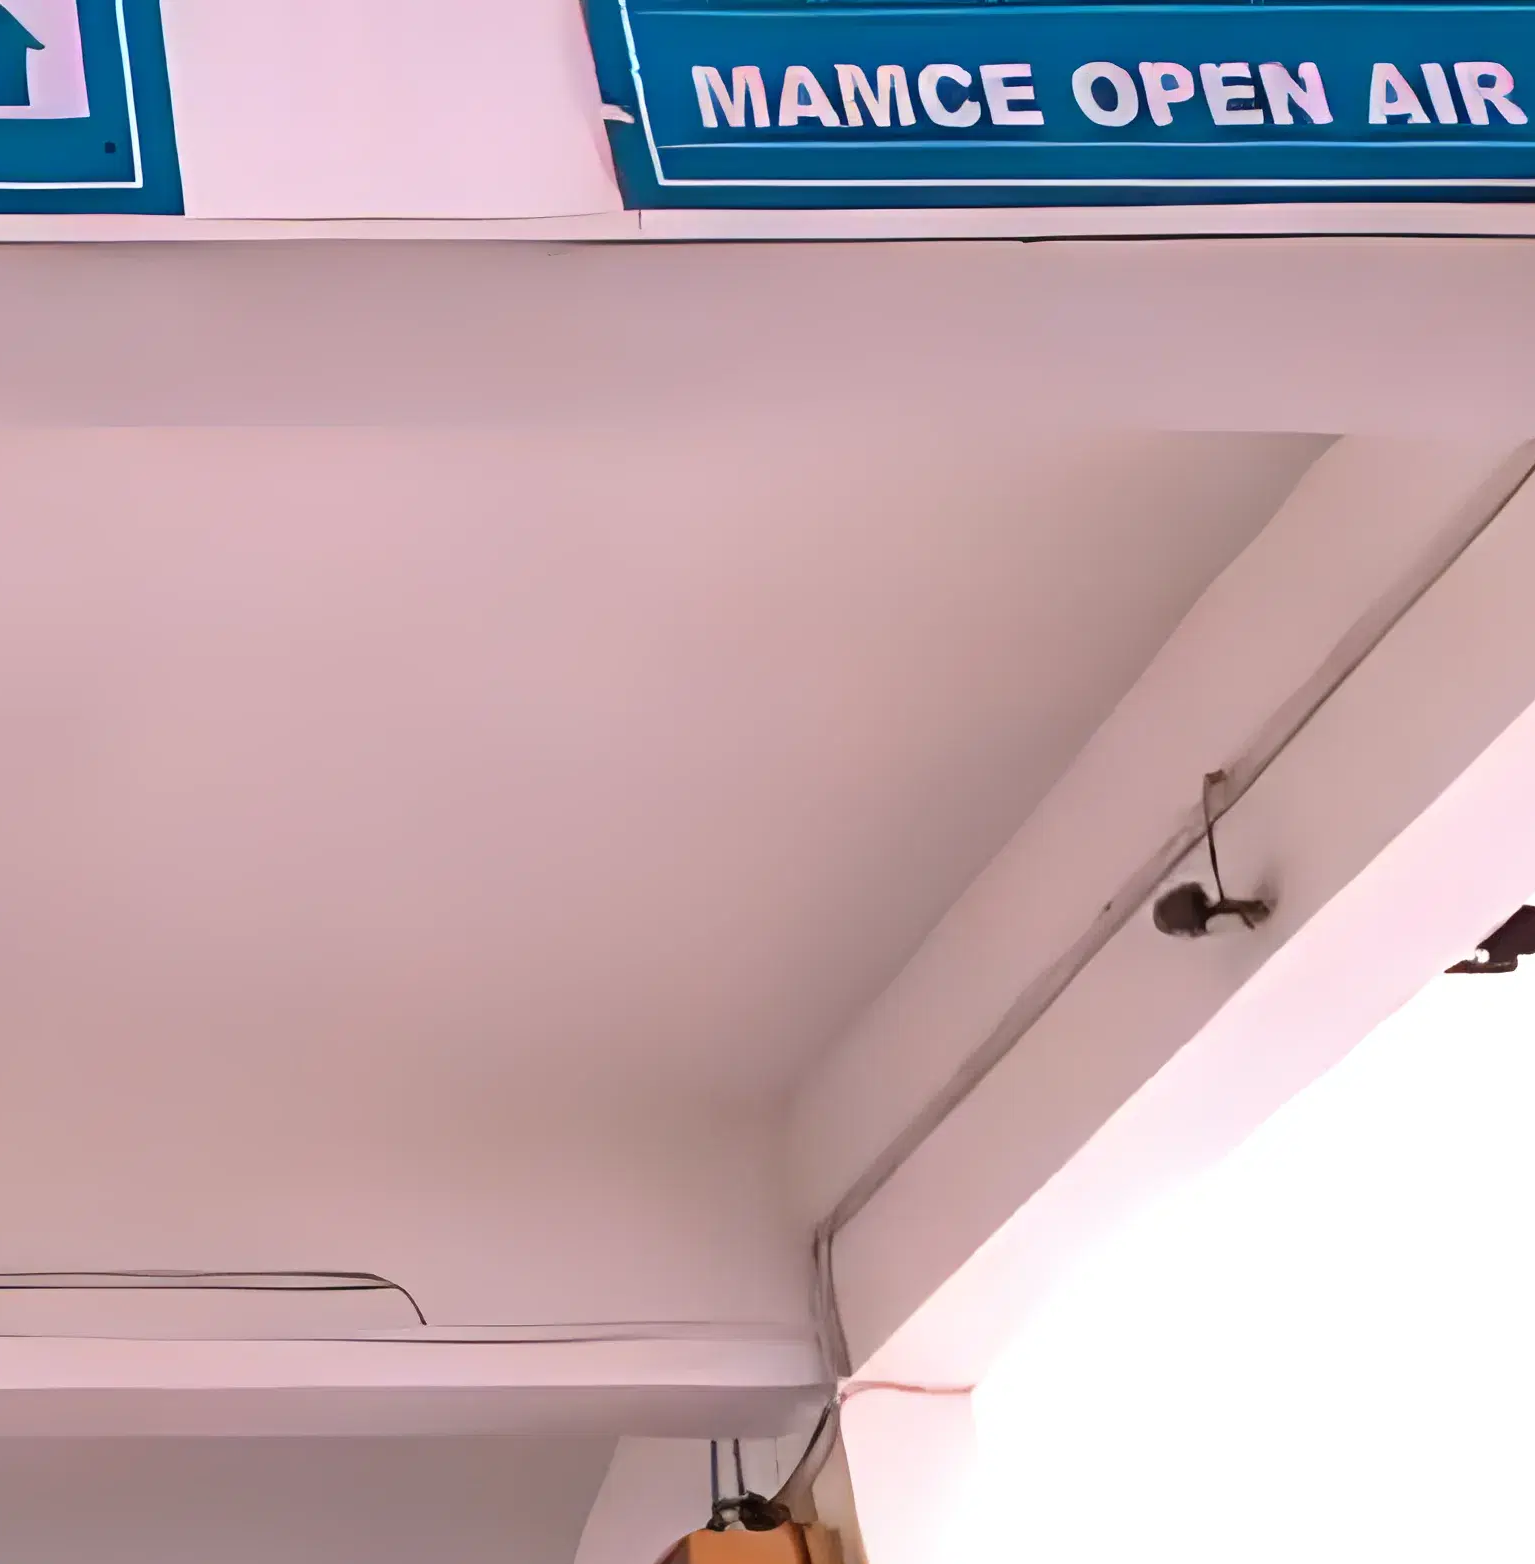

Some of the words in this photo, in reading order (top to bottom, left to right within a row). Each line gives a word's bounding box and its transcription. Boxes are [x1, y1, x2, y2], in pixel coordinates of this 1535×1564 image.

[691, 63, 1045, 128] MAMCE
[1071, 61, 1334, 127] OPEN
[1368, 61, 1529, 126] AIR
